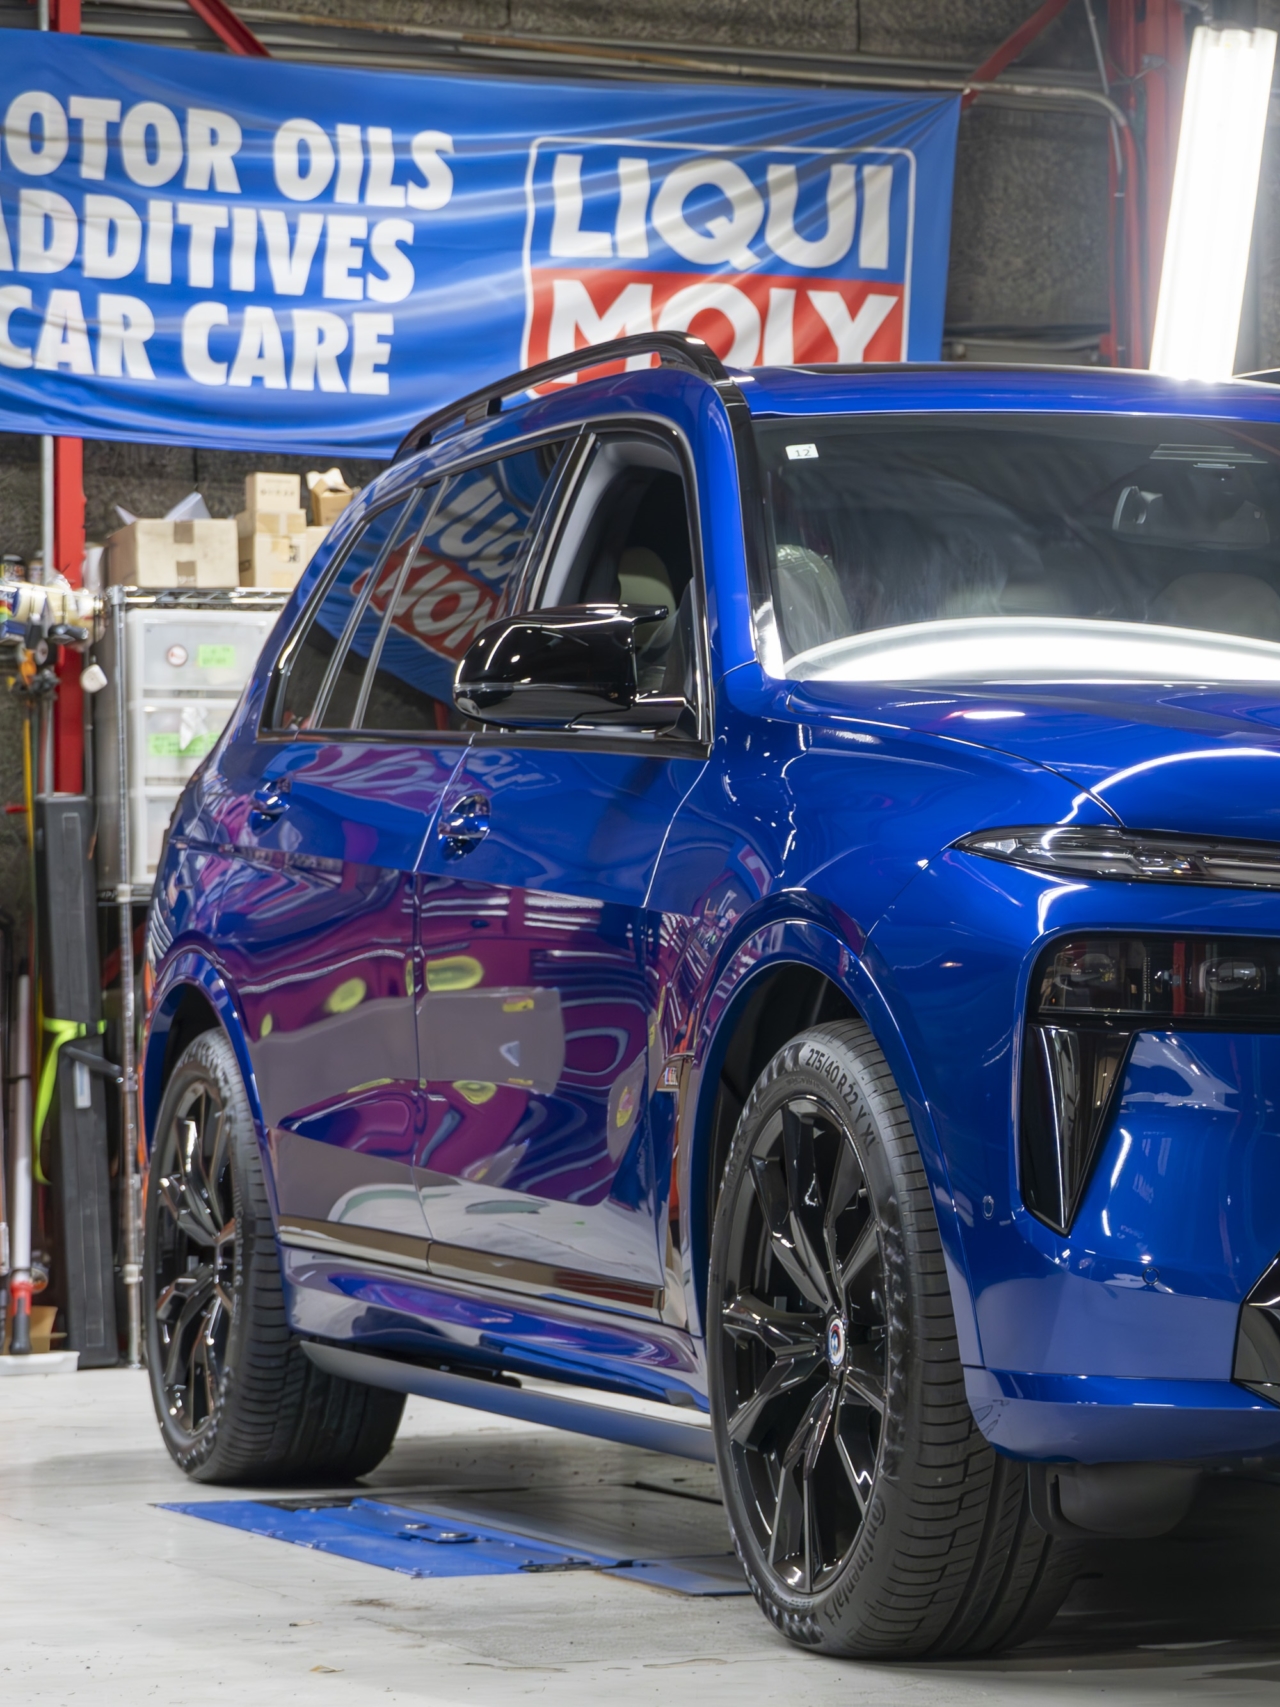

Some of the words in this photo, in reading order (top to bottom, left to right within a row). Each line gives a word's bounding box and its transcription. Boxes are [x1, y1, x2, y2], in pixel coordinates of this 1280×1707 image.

[5, 91, 243, 194] OTOR
[273, 118, 455, 210] OILS
[550, 153, 893, 271] LIQUI
[0, 188, 416, 303] DDITIVES
[0, 285, 157, 380] CAR
[181, 301, 394, 395] CARE
[805, 1047, 840, 1084] 275/40
[836, 1073, 848, 1095] R
[842, 1084, 859, 1112] 22
[855, 1104, 868, 1124] Y
[860, 1122, 877, 1157] XL
